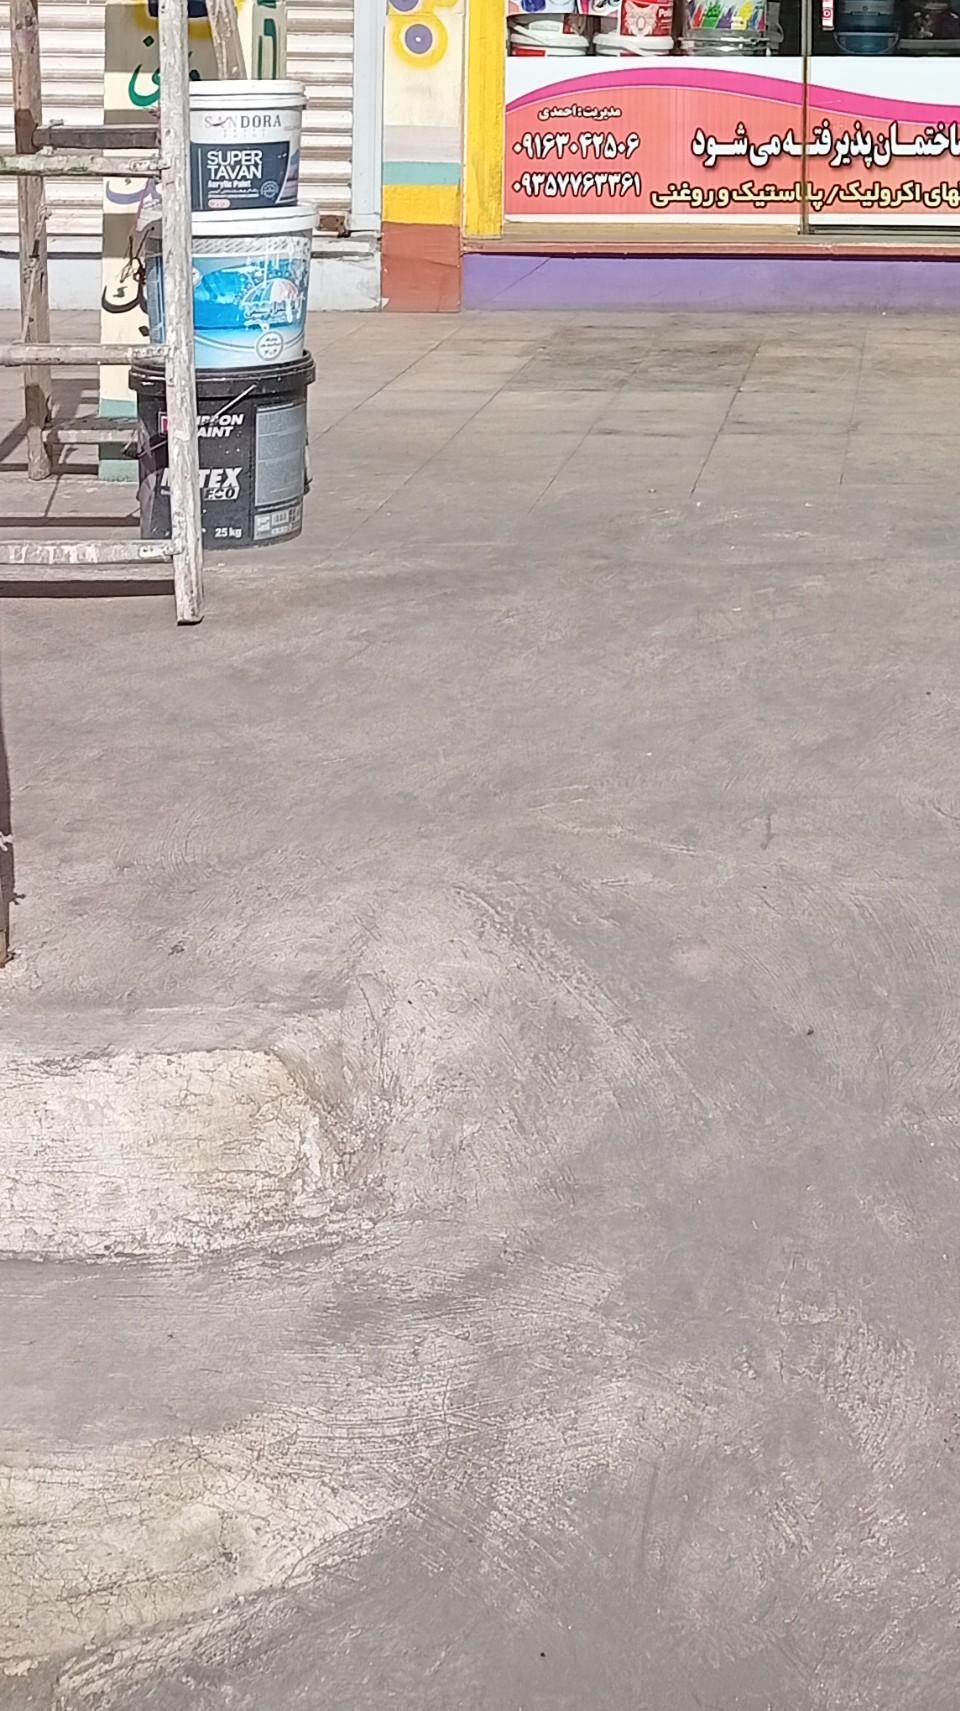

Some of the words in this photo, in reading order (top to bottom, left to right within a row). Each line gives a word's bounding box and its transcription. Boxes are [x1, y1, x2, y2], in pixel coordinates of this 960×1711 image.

[204, 114, 282, 128] SANDORA
[512, 132, 641, 159] ۰۹۱۶۳۰۴۲۵۰۶
[691, 121, 749, 168] شود
[750, 134, 782, 168] می
[782, 118, 873, 168] پذیرفته
[206, 150, 262, 165] SUPER
[207, 165, 262, 180] TAVAN
[207, 180, 232, 189] Acrylic
[232, 180, 251, 188] Paint
[512, 172, 642, 197] ۰۹۳۵۷۷۶۳۳۶۱
[650, 181, 716, 208] روغنی
[731, 179, 824, 211] پلاستیک
[838, 179, 922, 208] اکرولیک
[197, 426, 234, 437] AINT
[214, 527, 228, 537] 25
[228, 527, 242, 538] kg
